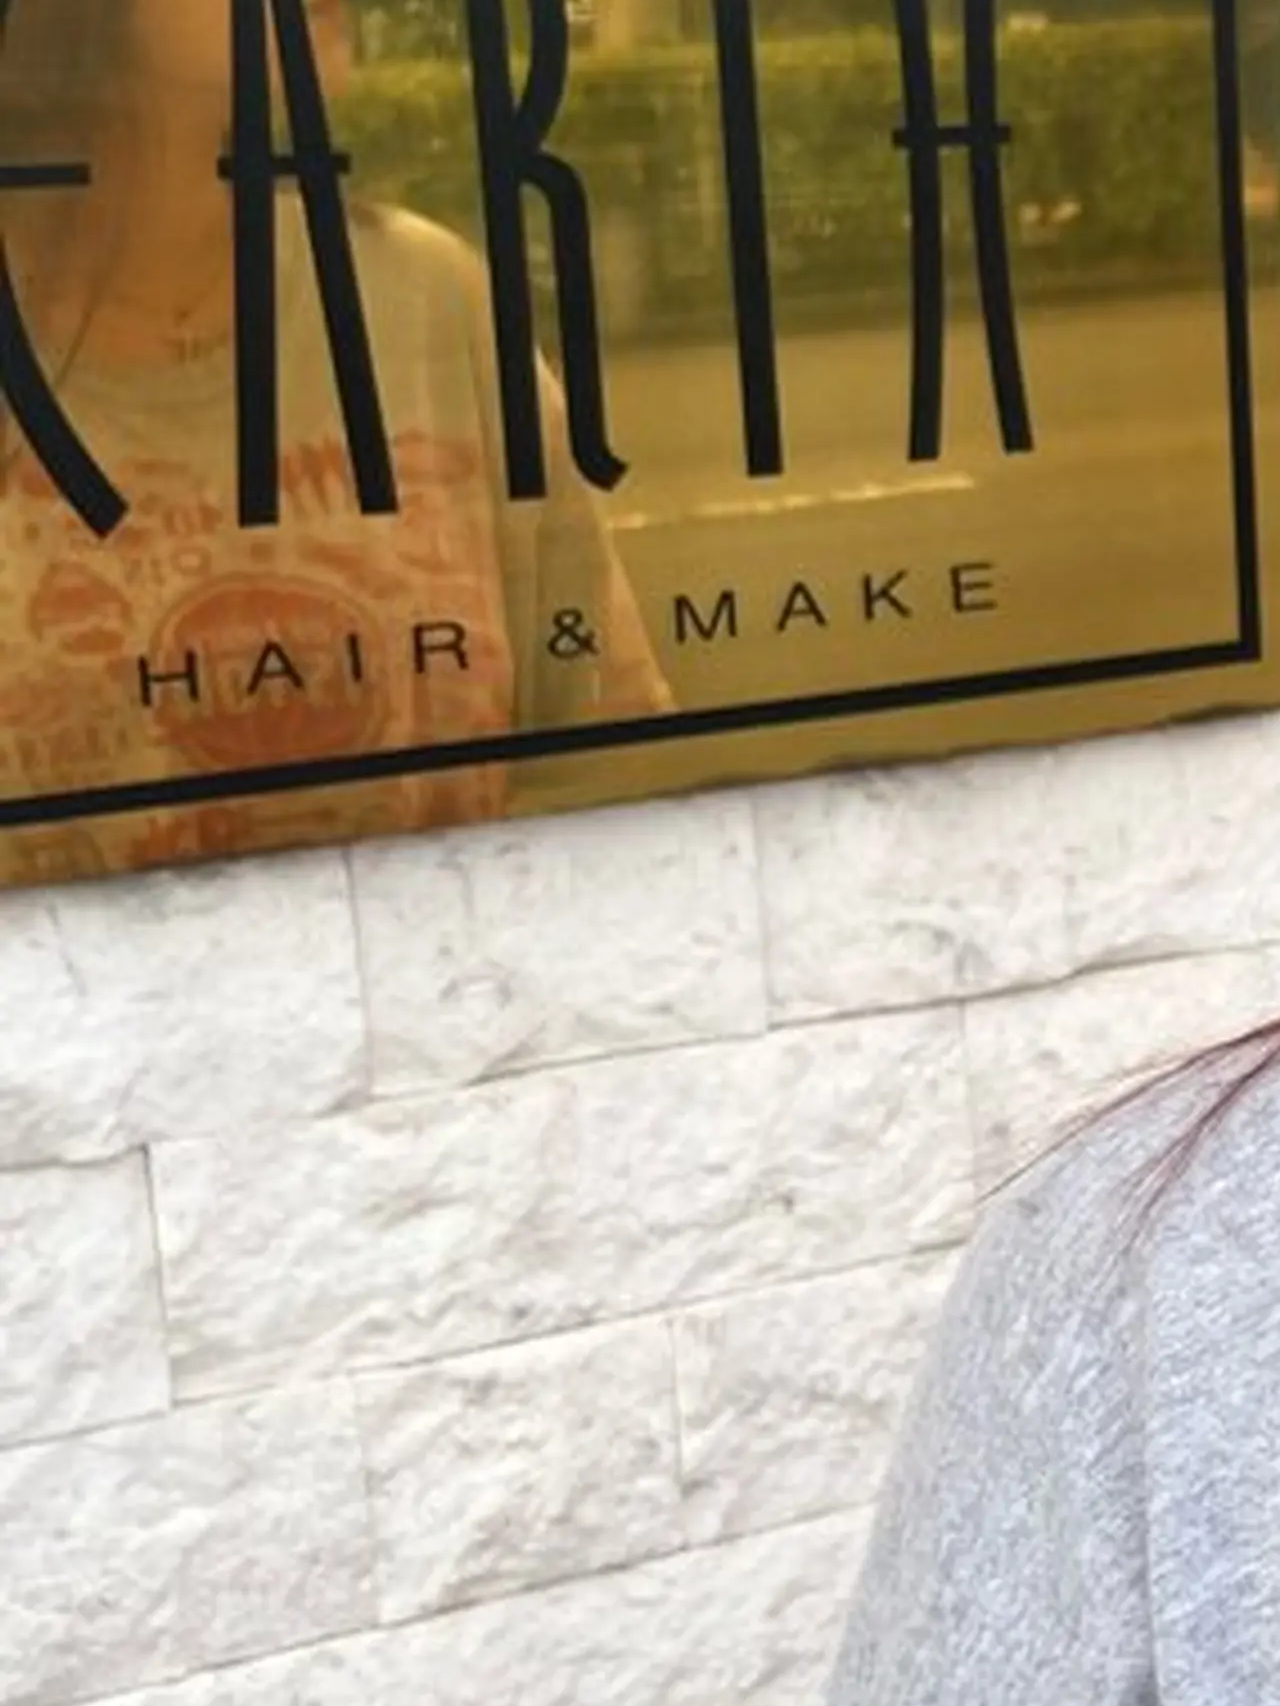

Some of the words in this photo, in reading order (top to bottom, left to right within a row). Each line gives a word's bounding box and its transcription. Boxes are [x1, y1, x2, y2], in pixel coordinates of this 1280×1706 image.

[137, 621, 469, 707] HAIR
[547, 608, 600, 661] &
[673, 562, 998, 645] MAKE
